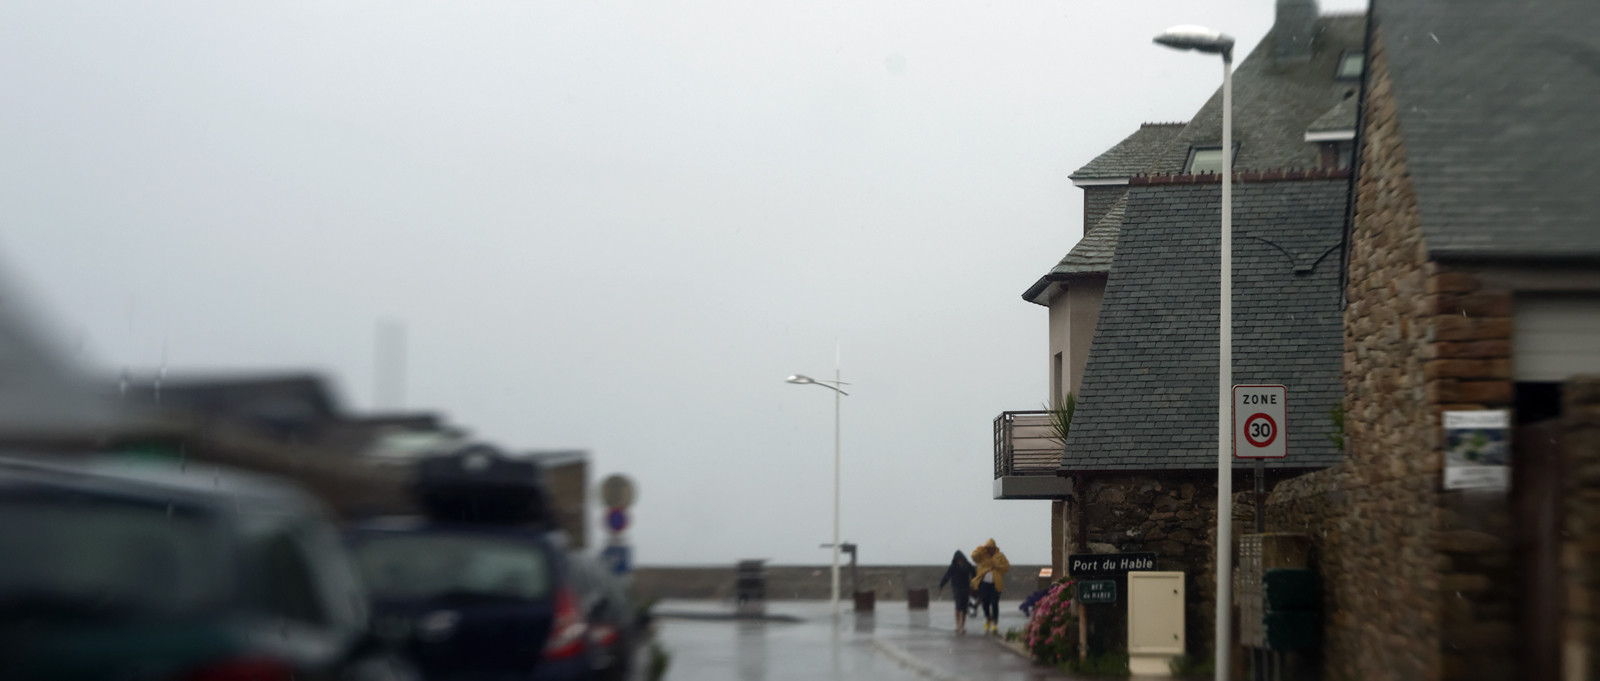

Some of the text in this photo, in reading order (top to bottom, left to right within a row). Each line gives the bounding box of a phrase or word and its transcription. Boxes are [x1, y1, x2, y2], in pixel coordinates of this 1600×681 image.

[1243, 394, 1277, 405] ZONE
[1251, 423, 1271, 438] 30
[1073, 558, 1154, 571] Port du Hable
